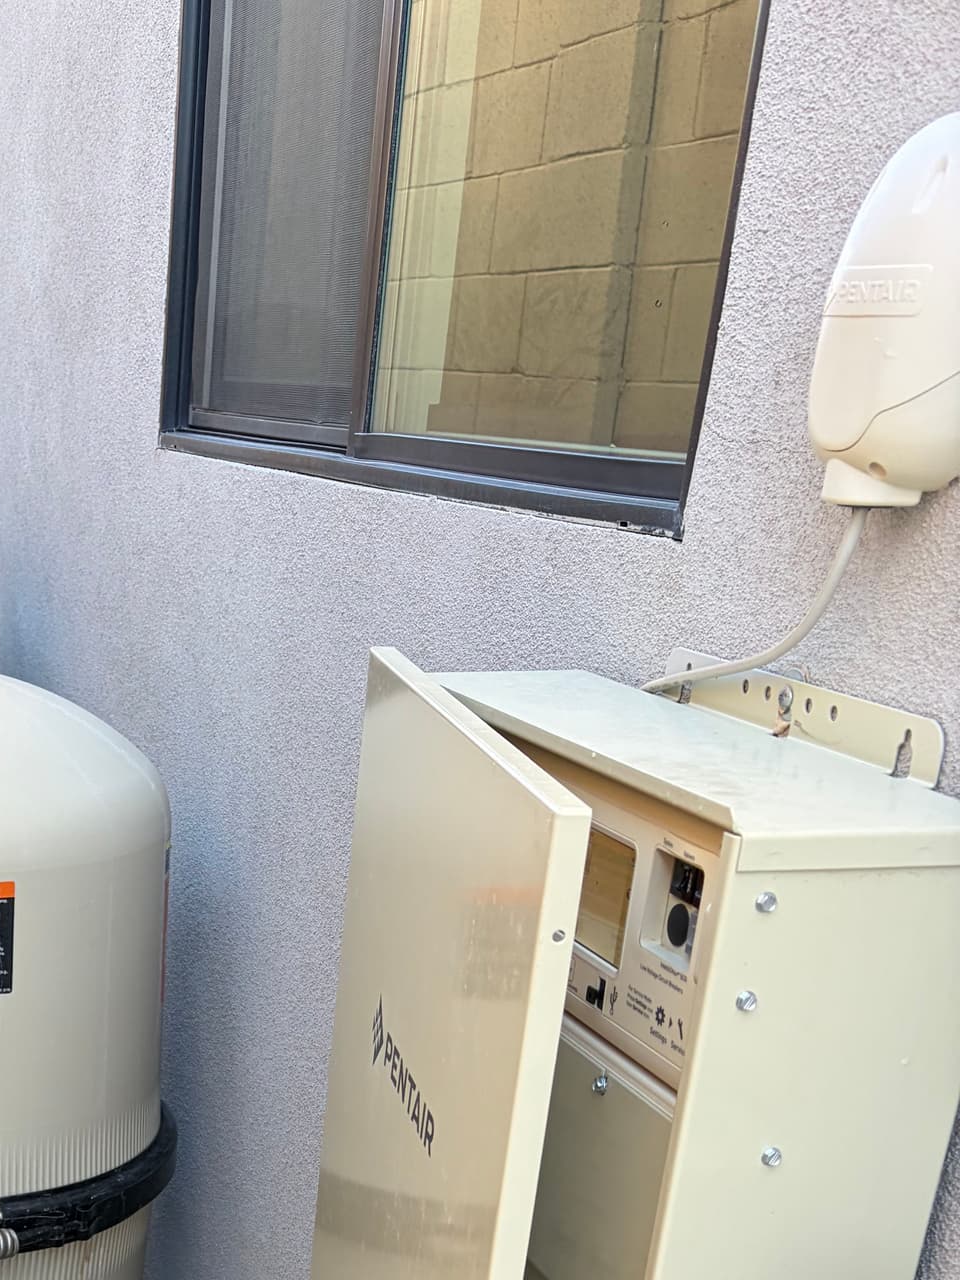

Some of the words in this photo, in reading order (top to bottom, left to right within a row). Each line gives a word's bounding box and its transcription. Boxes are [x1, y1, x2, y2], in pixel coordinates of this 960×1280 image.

[837, 279, 921, 304] PENTAIR
[650, 1026, 667, 1045] Settings
[384, 1031, 435, 1158] PENTAIR
